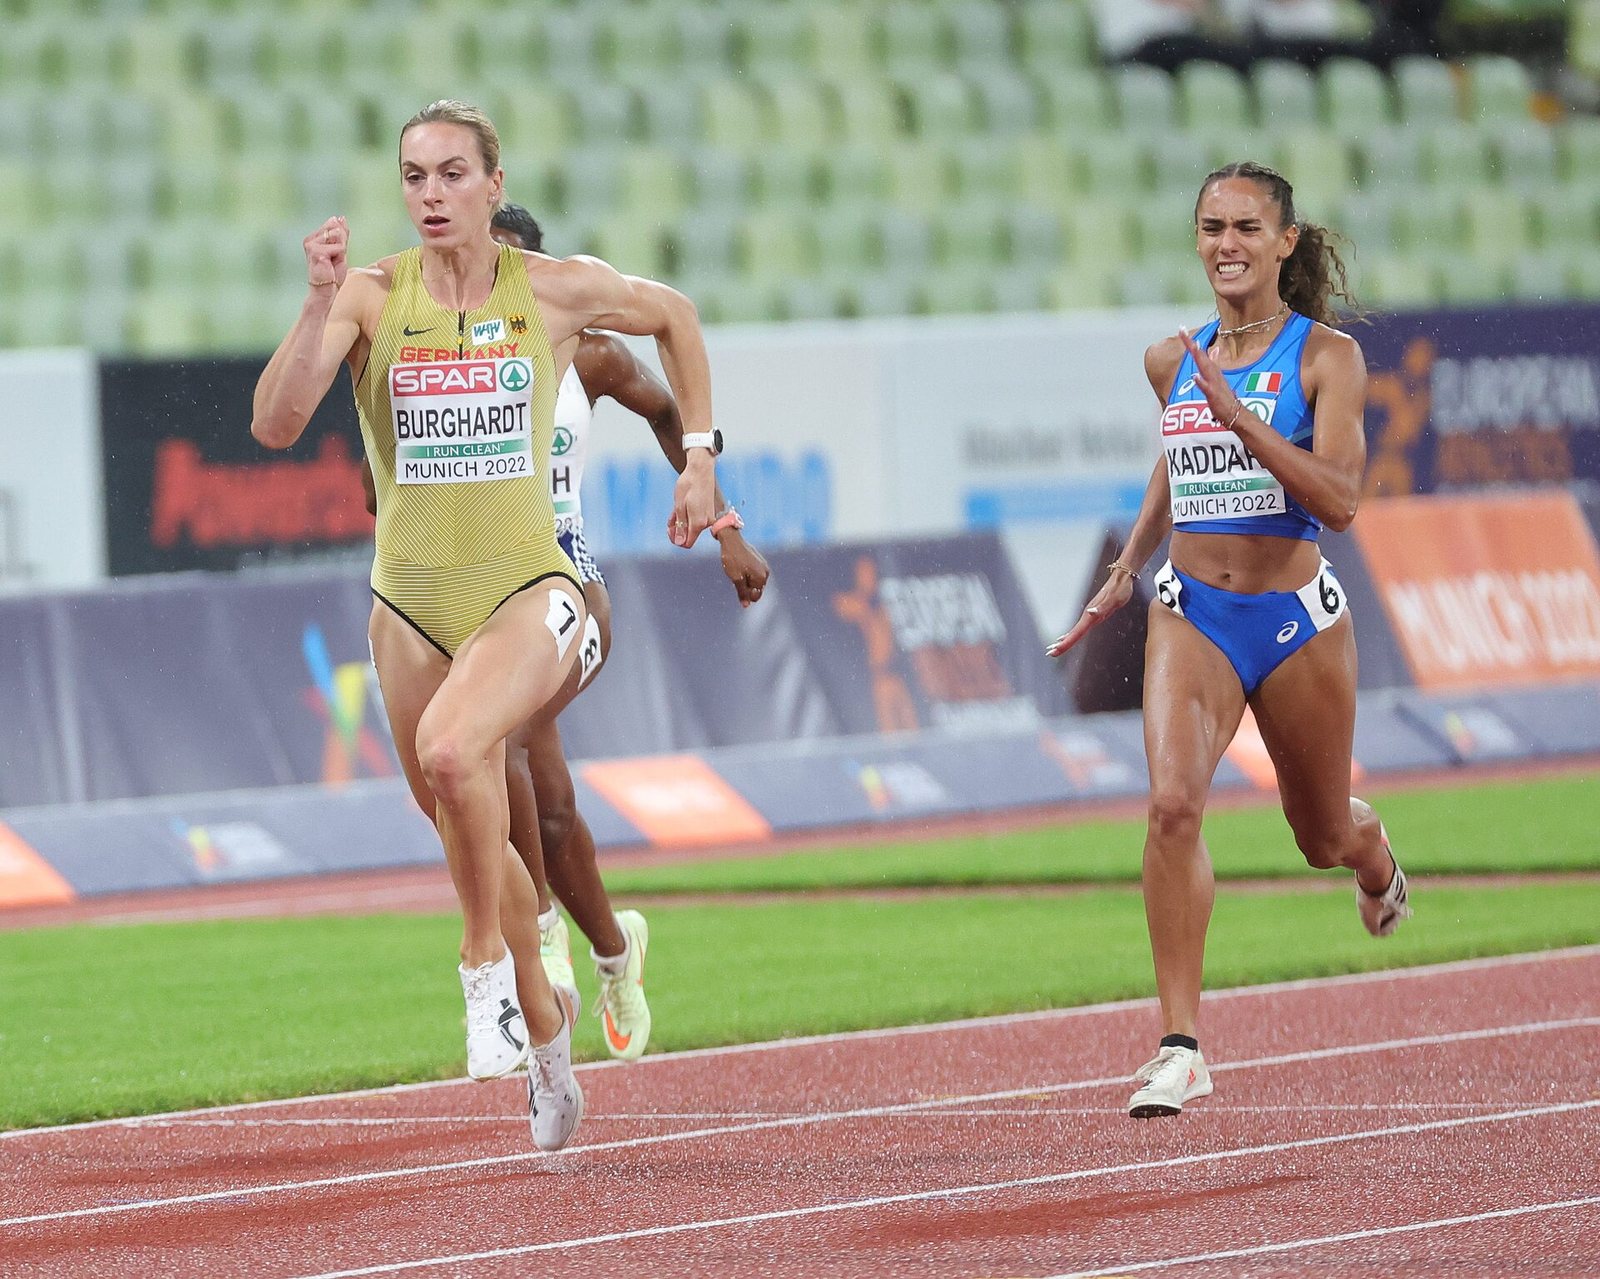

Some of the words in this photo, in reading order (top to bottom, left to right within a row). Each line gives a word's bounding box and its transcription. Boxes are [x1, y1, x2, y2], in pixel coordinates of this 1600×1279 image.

[400, 342, 519, 362] GERMANY
[395, 366, 493, 393] SPAR
[396, 402, 526, 439] BURGHARDT
[1164, 407, 1222, 431] SPA
[433, 446, 457, 457] RUN
[405, 461, 478, 479] MUNICH
[485, 456, 526, 475] 2022
[1189, 483, 1210, 494] RUN
[1174, 498, 1227, 517] MUNICH
[1232, 493, 1277, 513] 2022
[1319, 574, 1340, 614] 6
[558, 600, 576, 636] 7
